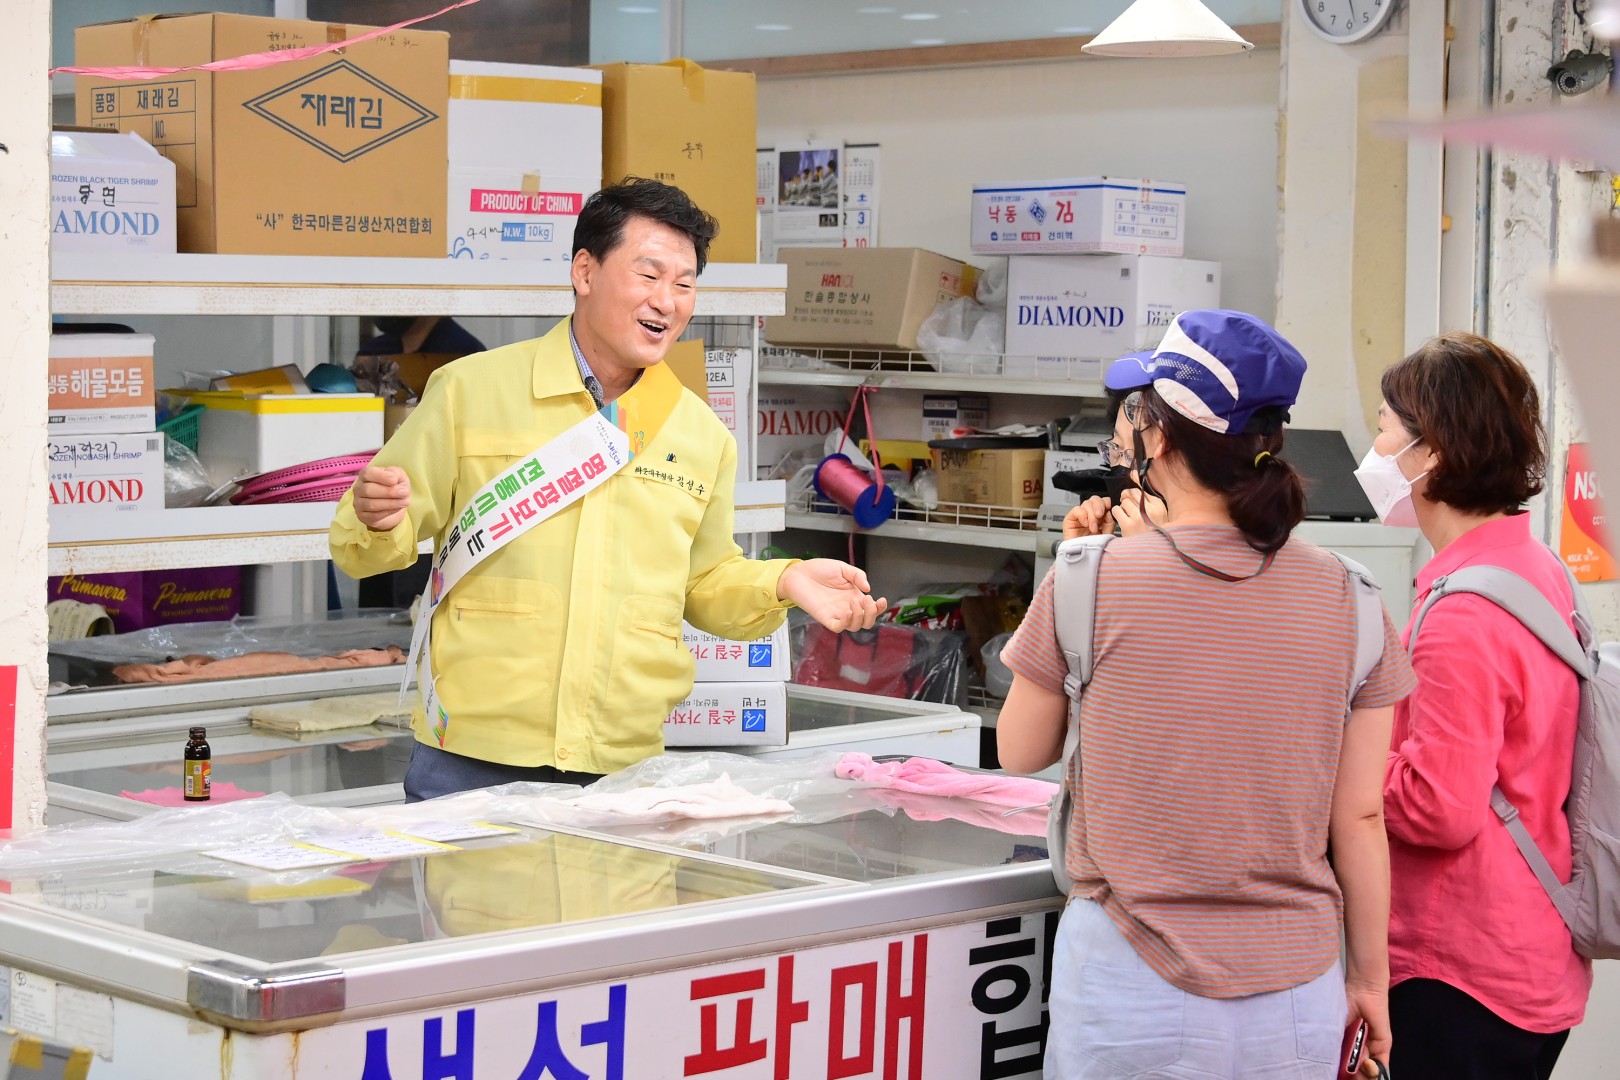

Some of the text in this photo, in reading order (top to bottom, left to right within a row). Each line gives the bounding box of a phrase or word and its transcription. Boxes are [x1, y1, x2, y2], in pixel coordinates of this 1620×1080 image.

[96, 87, 179, 113] 품명 재래김
[301, 93, 383, 129] 재래김
[80, 176, 105, 184] BLACK
[107, 177, 129, 185] TIGER
[131, 178, 159, 186] SHRIMP
[481, 192, 574, 213] PRODUCT OF CHINA
[1055, 200, 1075, 224] 김
[292, 213, 432, 234] 한국마른김생산자연합회
[858, 211, 865, 225] 3
[503, 226, 523, 238] N.W.
[528, 225, 550, 240] 10kg
[1018, 305, 1124, 328] DIAMOND
[71, 367, 144, 399] 해물모듬
[57, 574, 128, 602] Primavera
[153, 581, 233, 611] Primavera
[715, 645, 743, 660] 손질
[708, 710, 737, 725] 손질
